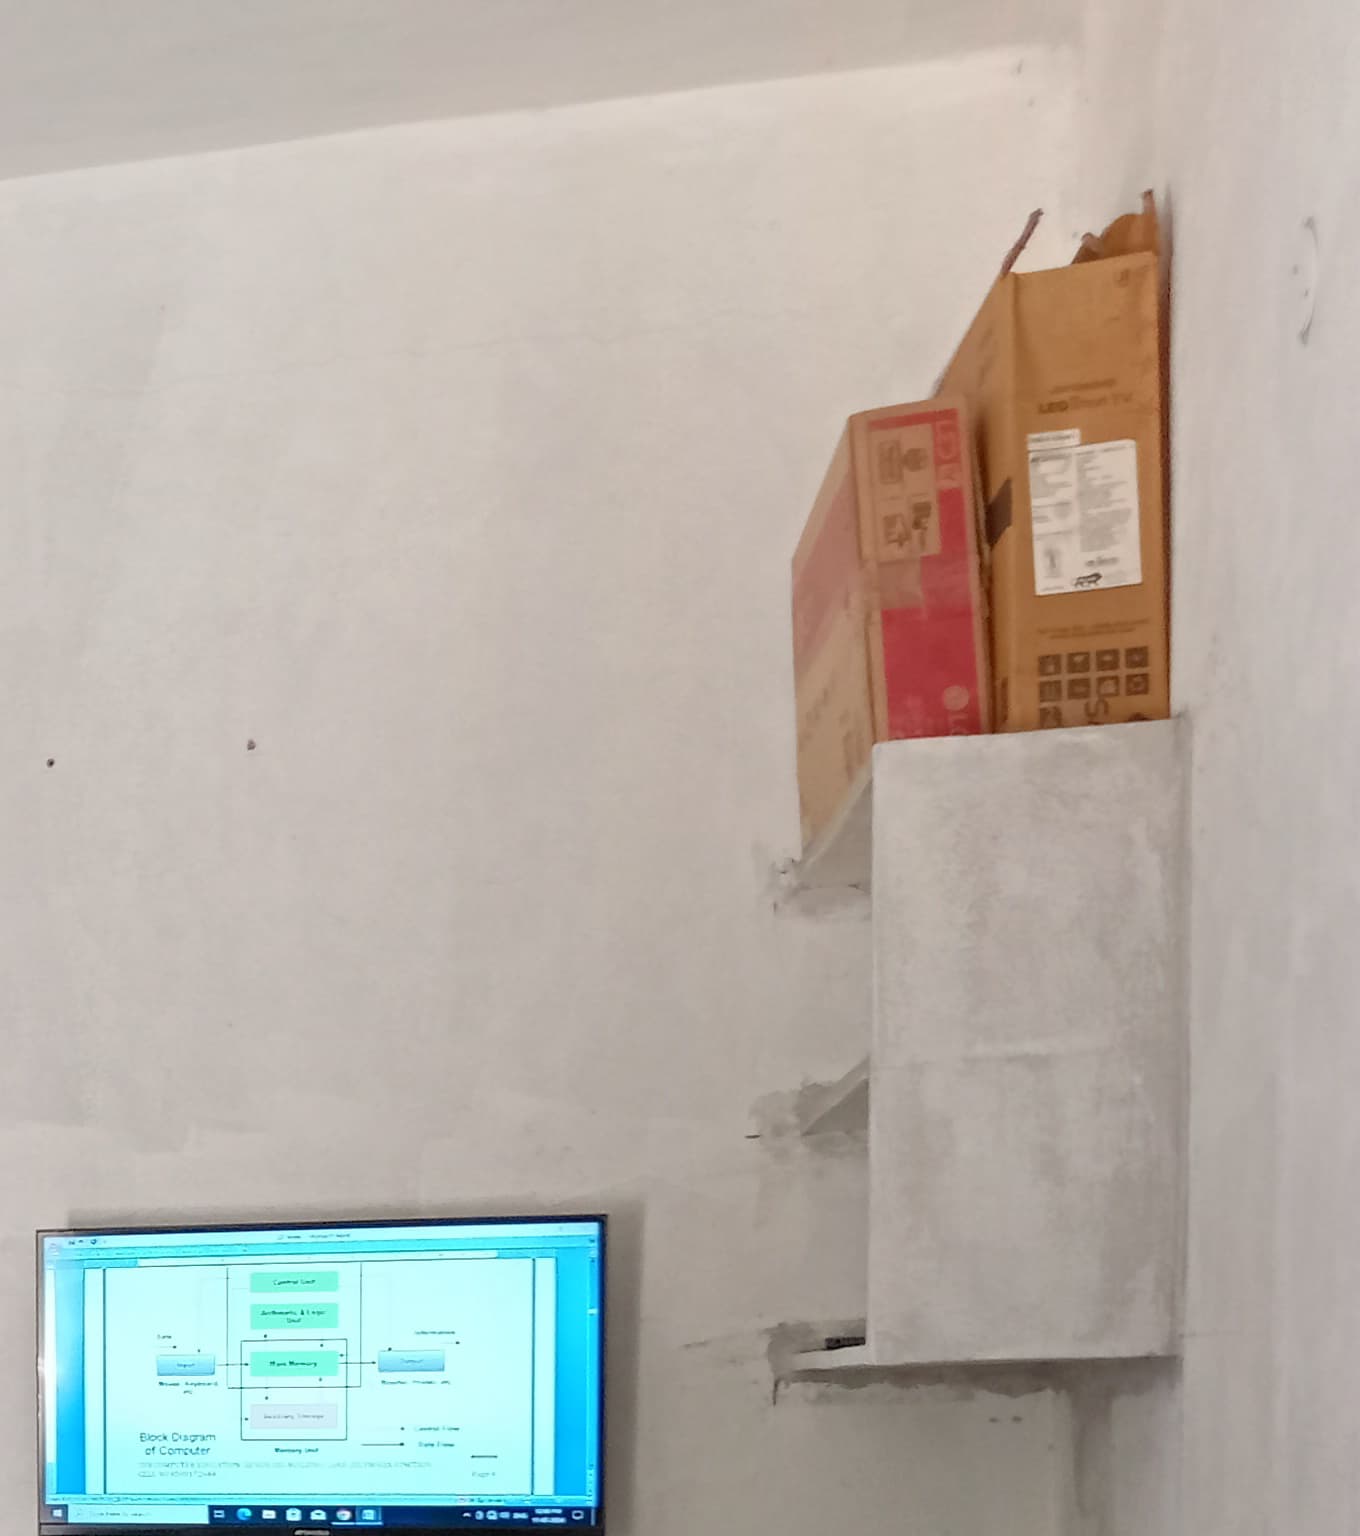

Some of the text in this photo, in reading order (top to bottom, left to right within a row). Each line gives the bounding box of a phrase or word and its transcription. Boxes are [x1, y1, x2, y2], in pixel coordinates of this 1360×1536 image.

[139, 1432, 216, 1444] Block Diagram
[144, 1444, 211, 1456] of Computer
